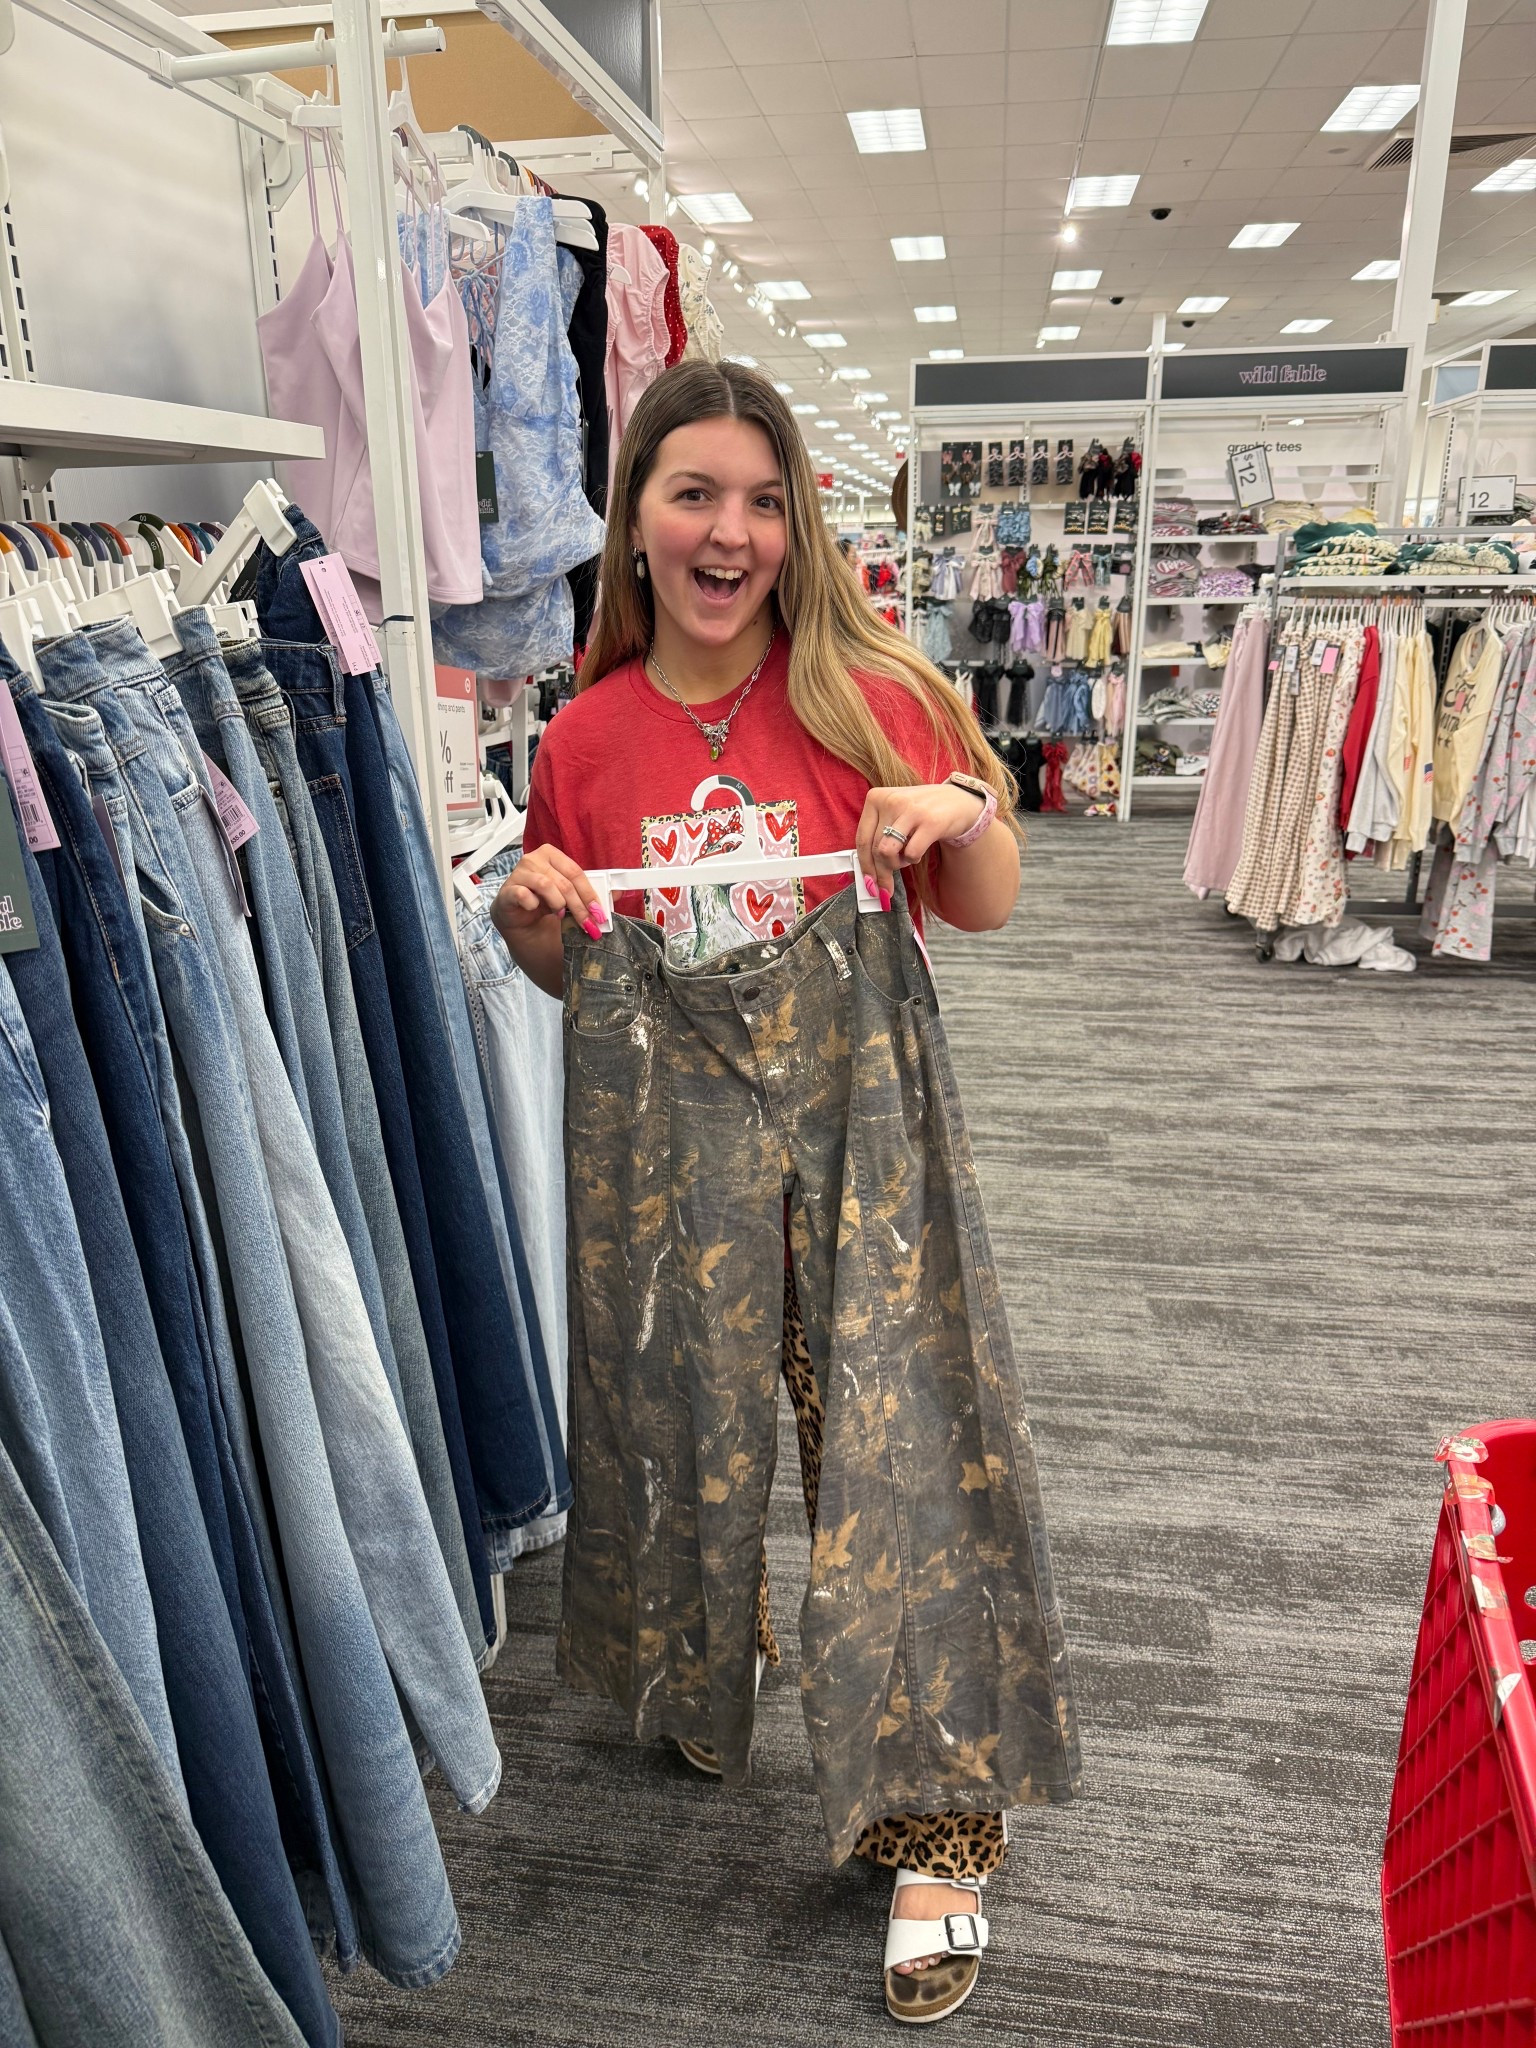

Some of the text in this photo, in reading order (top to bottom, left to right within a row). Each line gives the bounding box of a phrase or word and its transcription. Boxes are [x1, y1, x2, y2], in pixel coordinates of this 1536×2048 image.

[1239, 364, 1327, 384] wild fable
[1276, 441, 1302, 452] tees
[444, 770, 454, 793] ff
[735, 782, 743, 790] M
